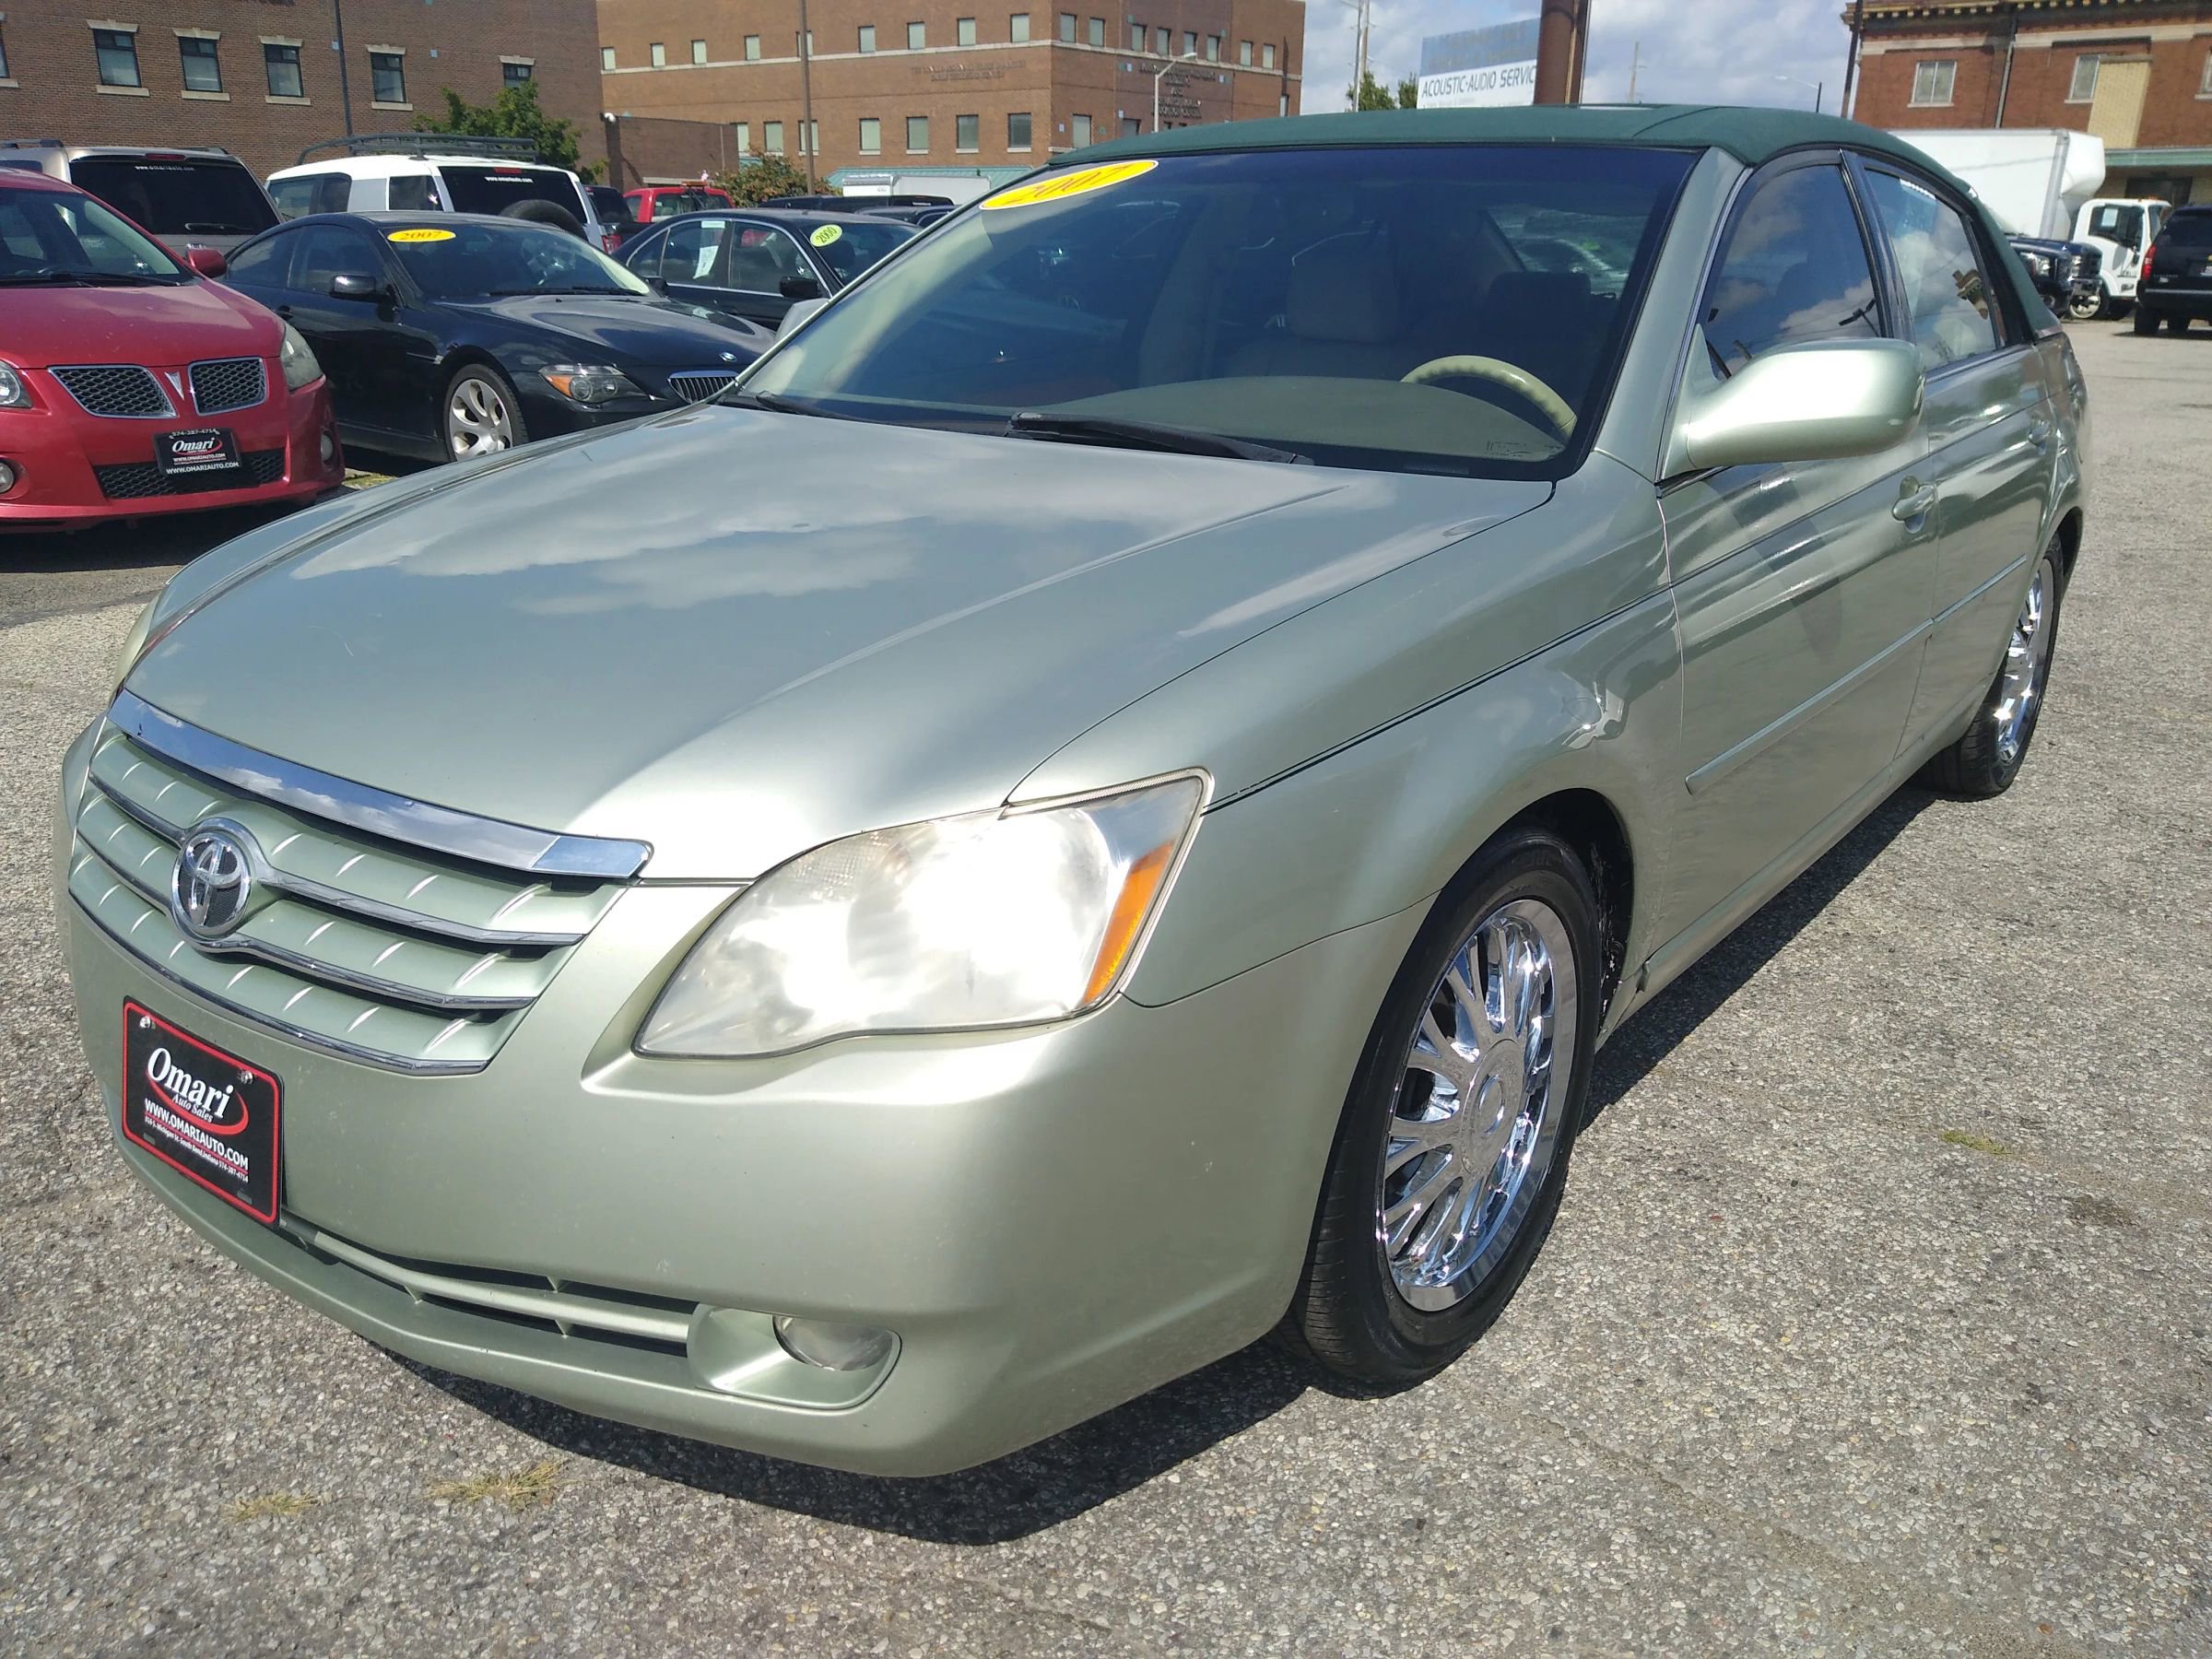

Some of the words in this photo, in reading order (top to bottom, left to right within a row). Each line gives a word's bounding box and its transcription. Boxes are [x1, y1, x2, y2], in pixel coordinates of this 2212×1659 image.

[398, 231, 442, 241] 2007
[172, 437, 215, 453] Omari
[166, 462, 240, 475] WWW.OMARIAUTO.COM
[147, 1047, 234, 1118] Omari
[172, 1093, 192, 1111] Auto
[192, 1104, 214, 1123] Sales
[145, 1098, 249, 1171] WWW.OMARIAUTO.COM
